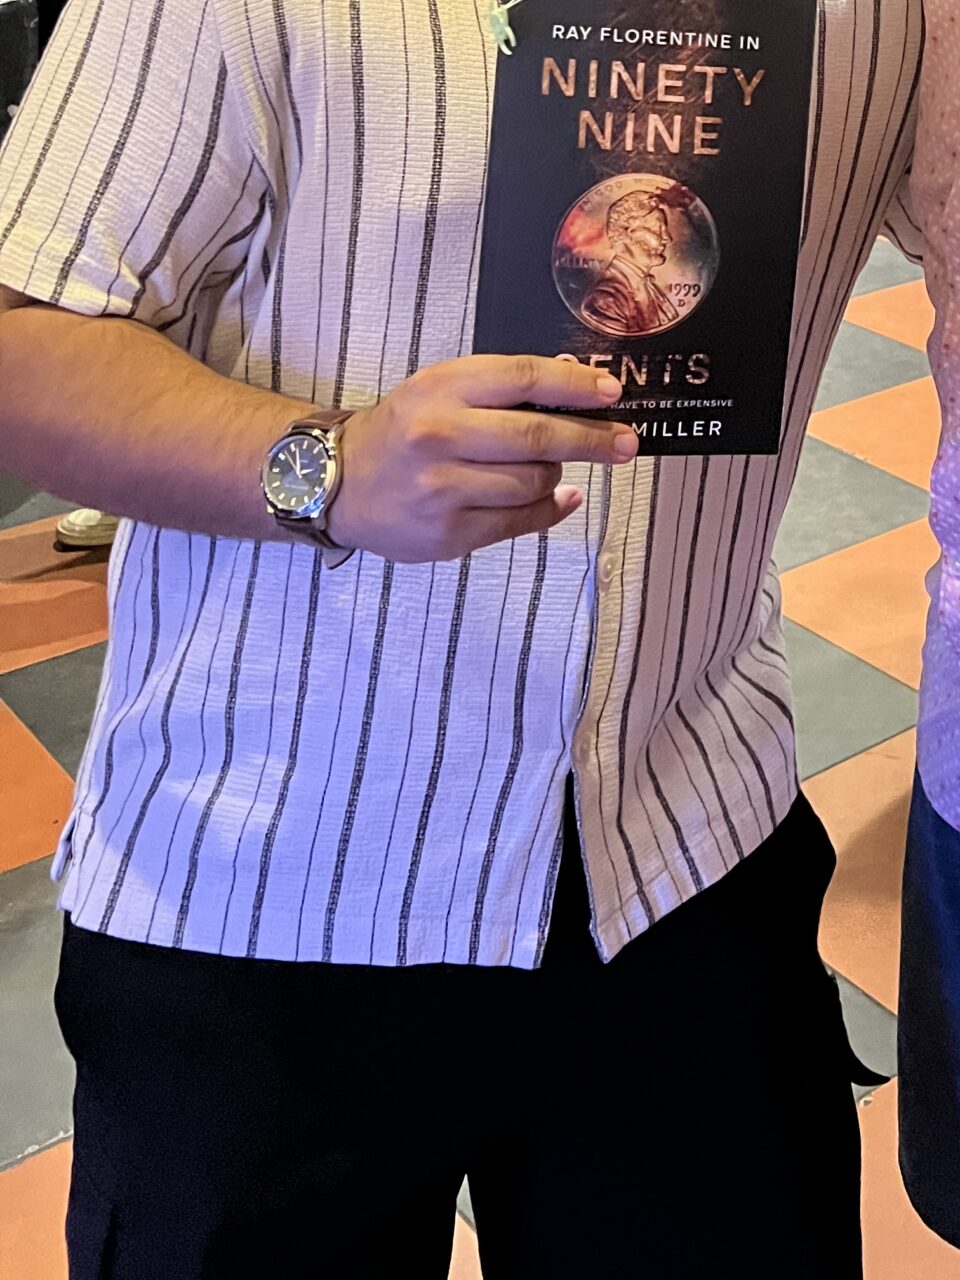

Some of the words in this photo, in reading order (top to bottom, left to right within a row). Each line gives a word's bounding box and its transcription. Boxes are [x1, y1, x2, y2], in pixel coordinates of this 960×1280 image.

[552, 24, 592, 41] RAY
[600, 27, 731, 49] FLORENTINE
[739, 36, 760, 50] IN
[541, 57, 765, 106] NINETY
[578, 110, 723, 156] NINE
[669, 283, 702, 298] 1999
[677, 298, 686, 308] D
[611, 401, 638, 410] HAVE
[643, 400, 656, 408] TO
[659, 400, 674, 408] BE
[676, 399, 734, 408] EXPENSIVE
[631, 421, 722, 437] MILLER
